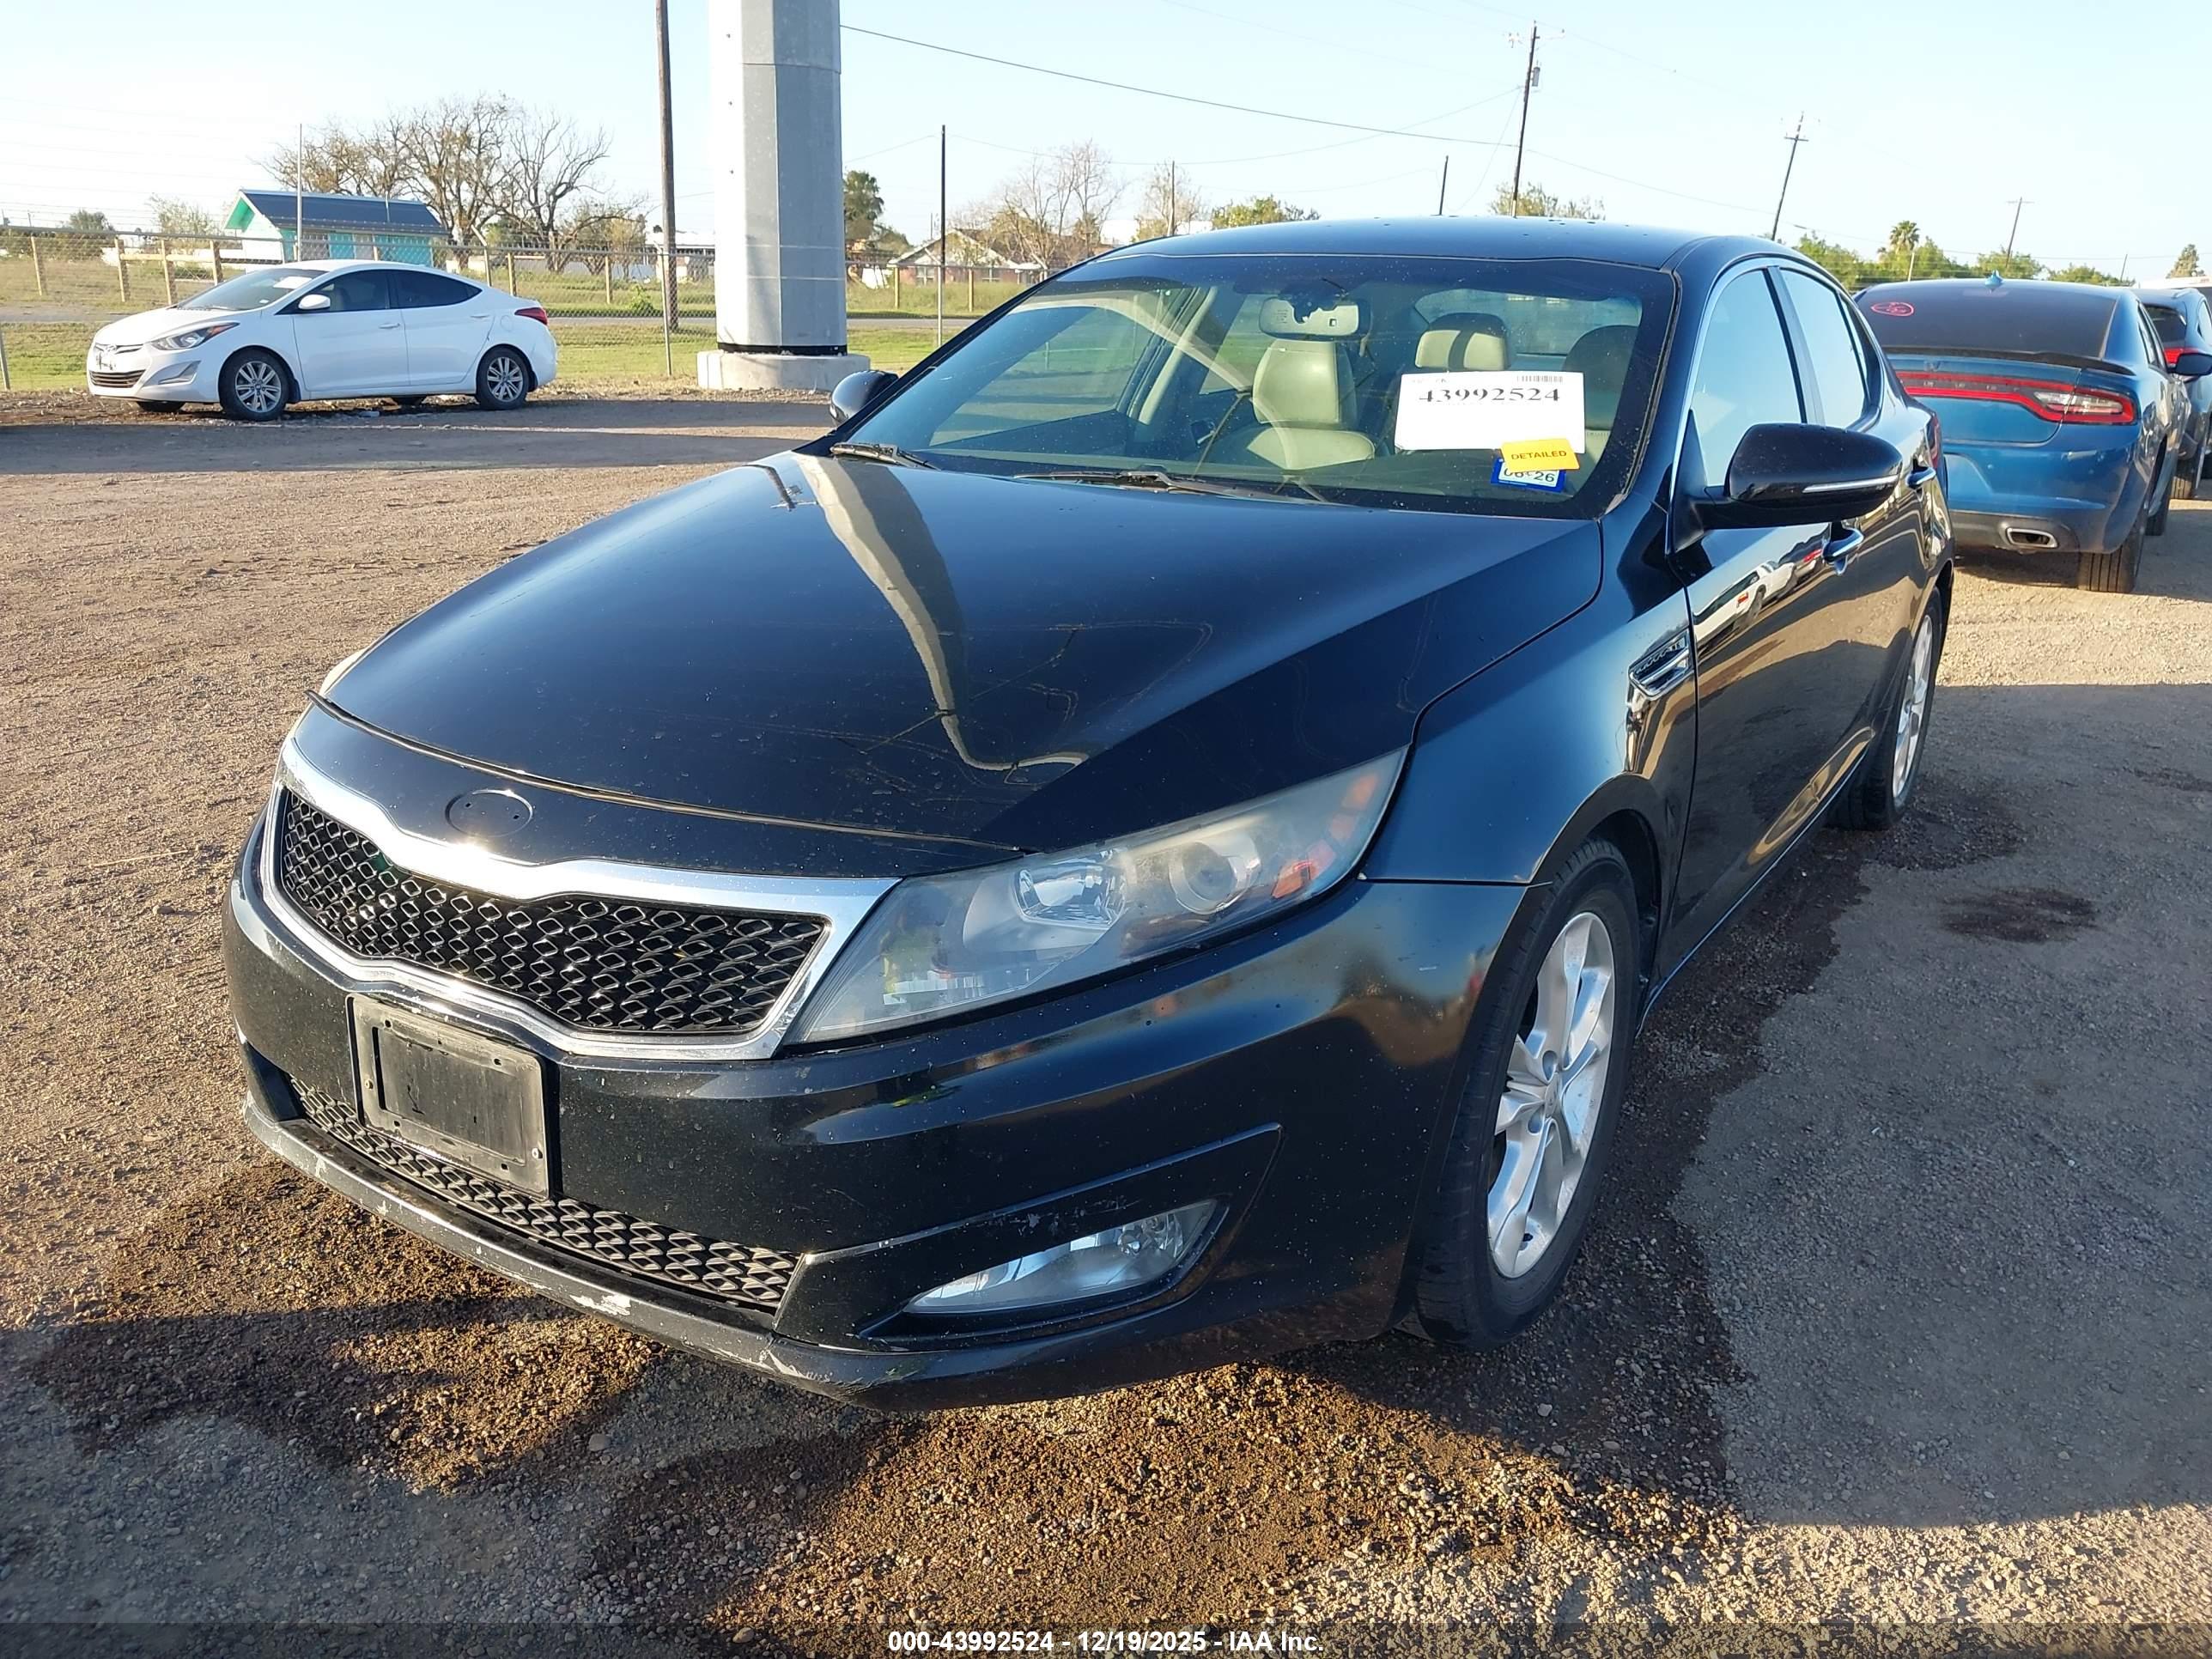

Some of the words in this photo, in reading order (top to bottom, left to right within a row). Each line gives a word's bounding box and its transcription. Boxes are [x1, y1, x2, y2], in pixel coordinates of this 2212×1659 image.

[1419, 387, 1561, 404] 43992524
[1510, 450, 1567, 460] DETAILED
[1534, 471, 1556, 483] 26
